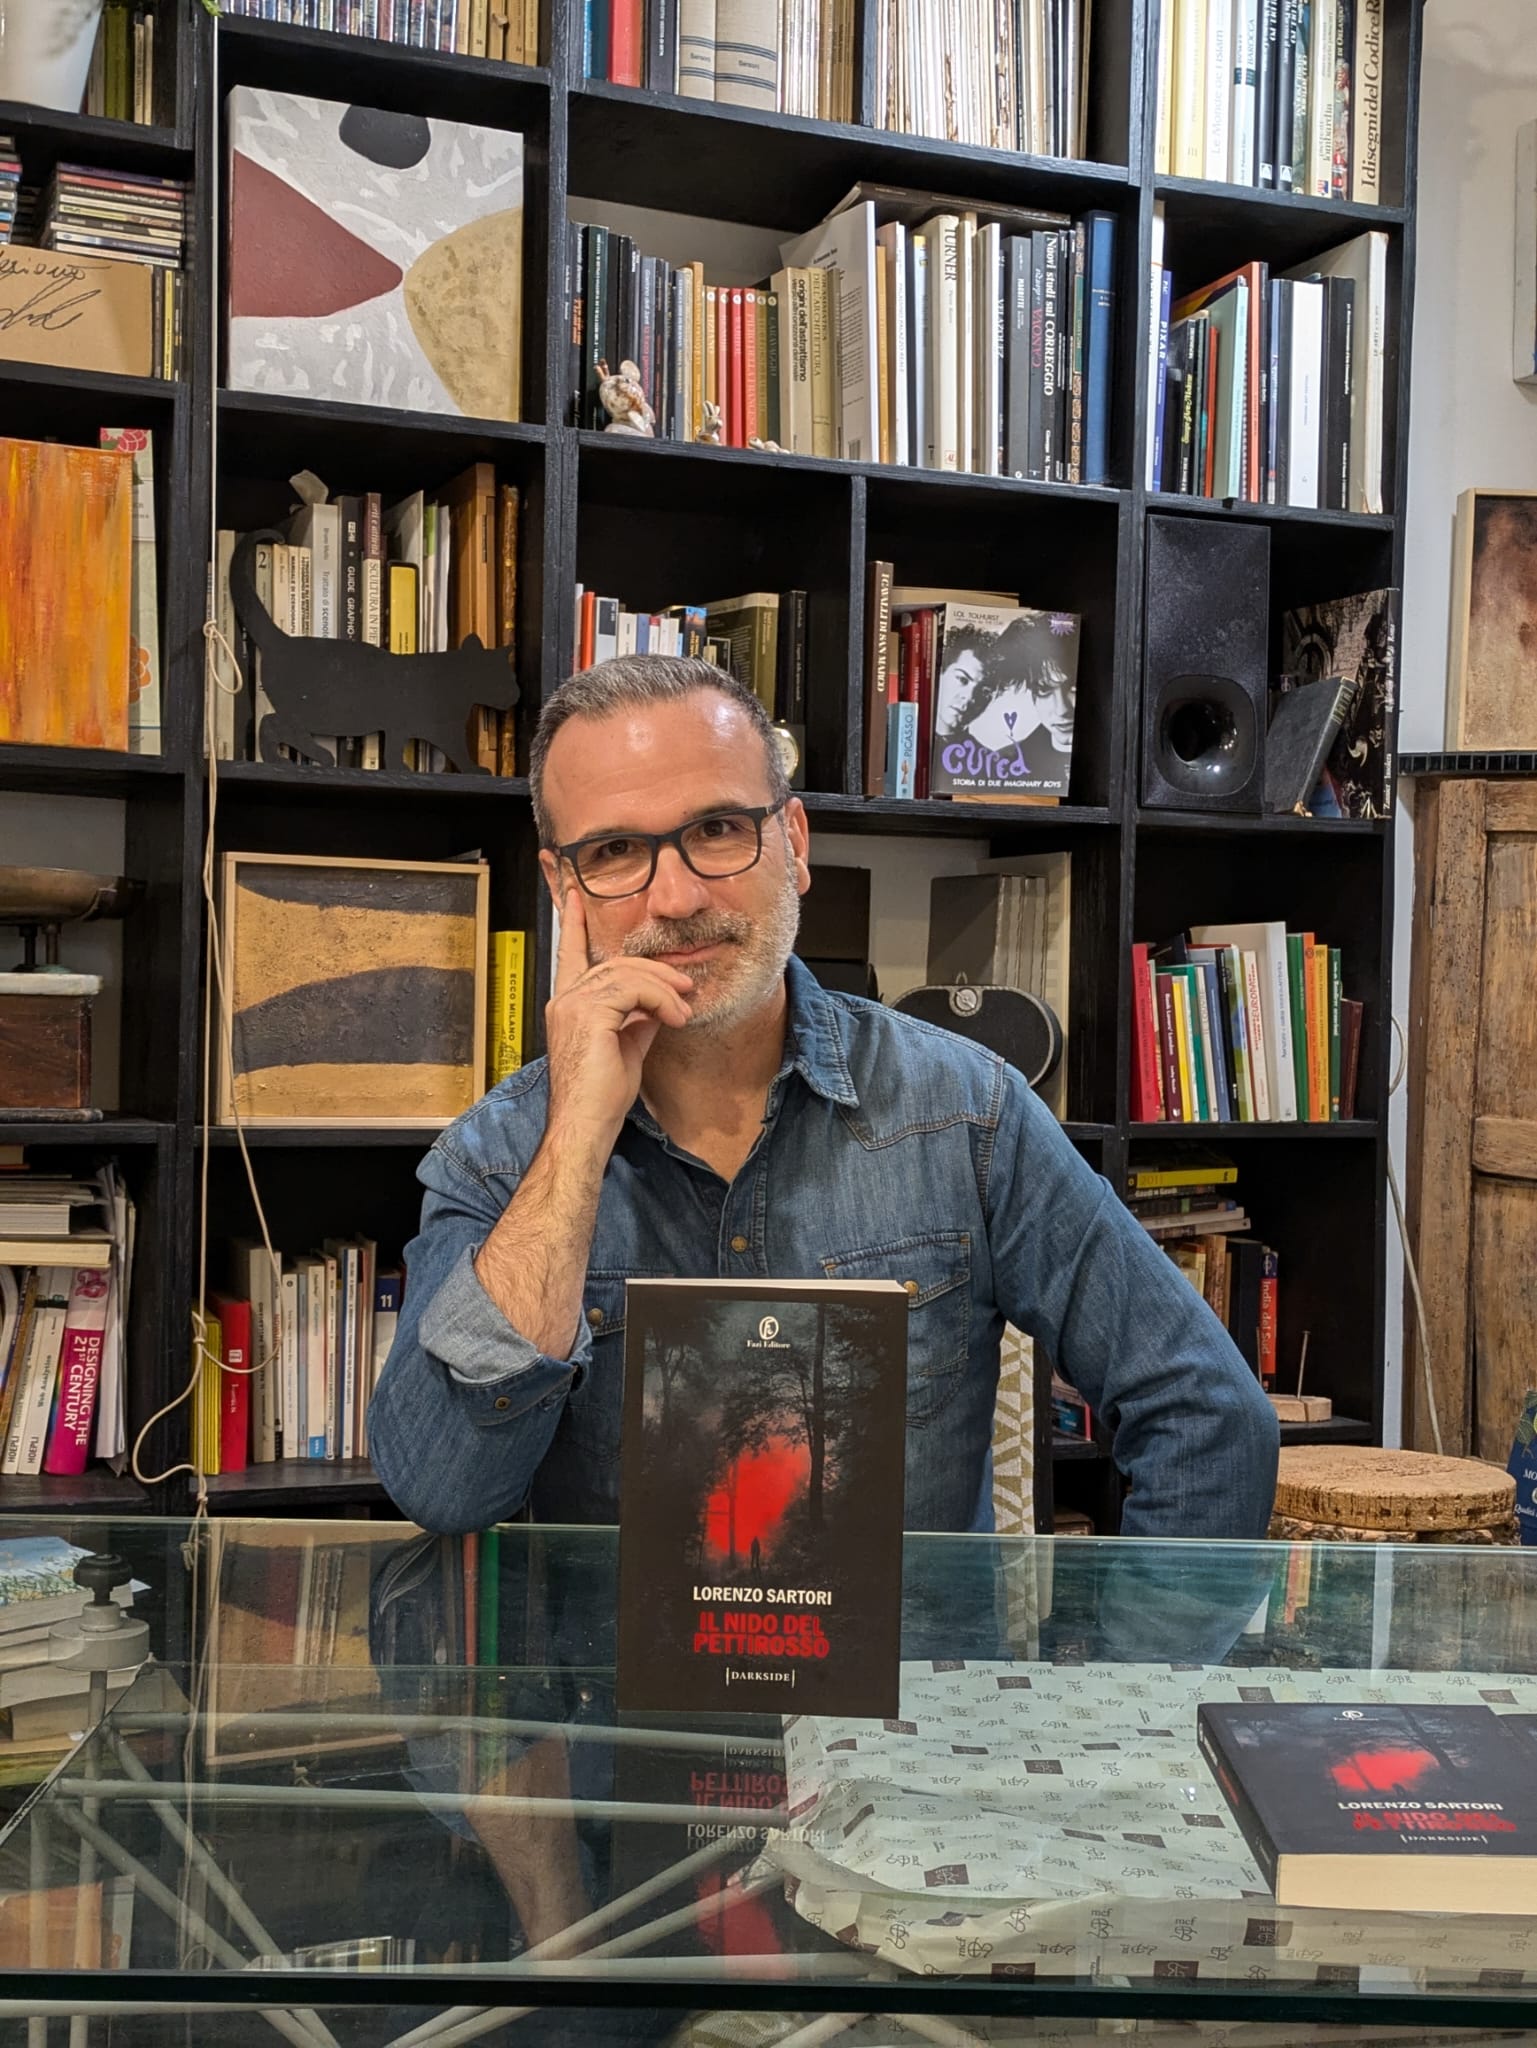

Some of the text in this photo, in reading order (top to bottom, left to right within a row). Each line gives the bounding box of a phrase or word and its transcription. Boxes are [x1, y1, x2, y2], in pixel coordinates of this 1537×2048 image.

[1363, 14, 1381, 81] Codice
[1363, 84, 1379, 110] del
[1361, 111, 1380, 178] disegni
[943, 227, 958, 281] TURNER
[796, 278, 809, 382] origini dell'astrattismo
[1043, 236, 1057, 397] Nuovi studi sul CORREGGIO
[1032, 307, 1044, 369] CANOVA
[1158, 319, 1168, 360] PIXAR
[258, 550, 267, 568] 2
[322, 570, 331, 599] Trattato
[347, 566, 356, 592] GUIDE
[368, 561, 379, 614] SCULTURA
[879, 578, 889, 620] CAVALLI
[369, 614, 379, 625] IN
[878, 621, 888, 633] DI
[953, 610, 999, 621] LOL TOLHURST
[878, 632, 888, 655] SAN
[876, 655, 887, 693] MARCO
[903, 713, 914, 758] PICASSO
[952, 778, 1062, 789] STORIA DI DUE IMAGINARY BOYS
[508, 972, 517, 1042] ECCO MILANO
[380, 1294, 393, 1308] 11
[1261, 1280, 1272, 1355] India del Sud
[63, 1335, 88, 1431] 21ST CENTURY
[74, 1336, 101, 1446] DESIGNING THE
[7, 1435, 20, 1463] HOEPLI
[27, 1435, 39, 1464] HOEPLI
[693, 1586, 832, 1606] LORENZO SARTORI
[699, 1611, 825, 1637] IL NIDO DEL
[693, 1631, 830, 1659] PETTIROSSO
[731, 1671, 791, 1682] DARKSIDE
[1337, 1801, 1504, 1811] LORENZO SARTORI
